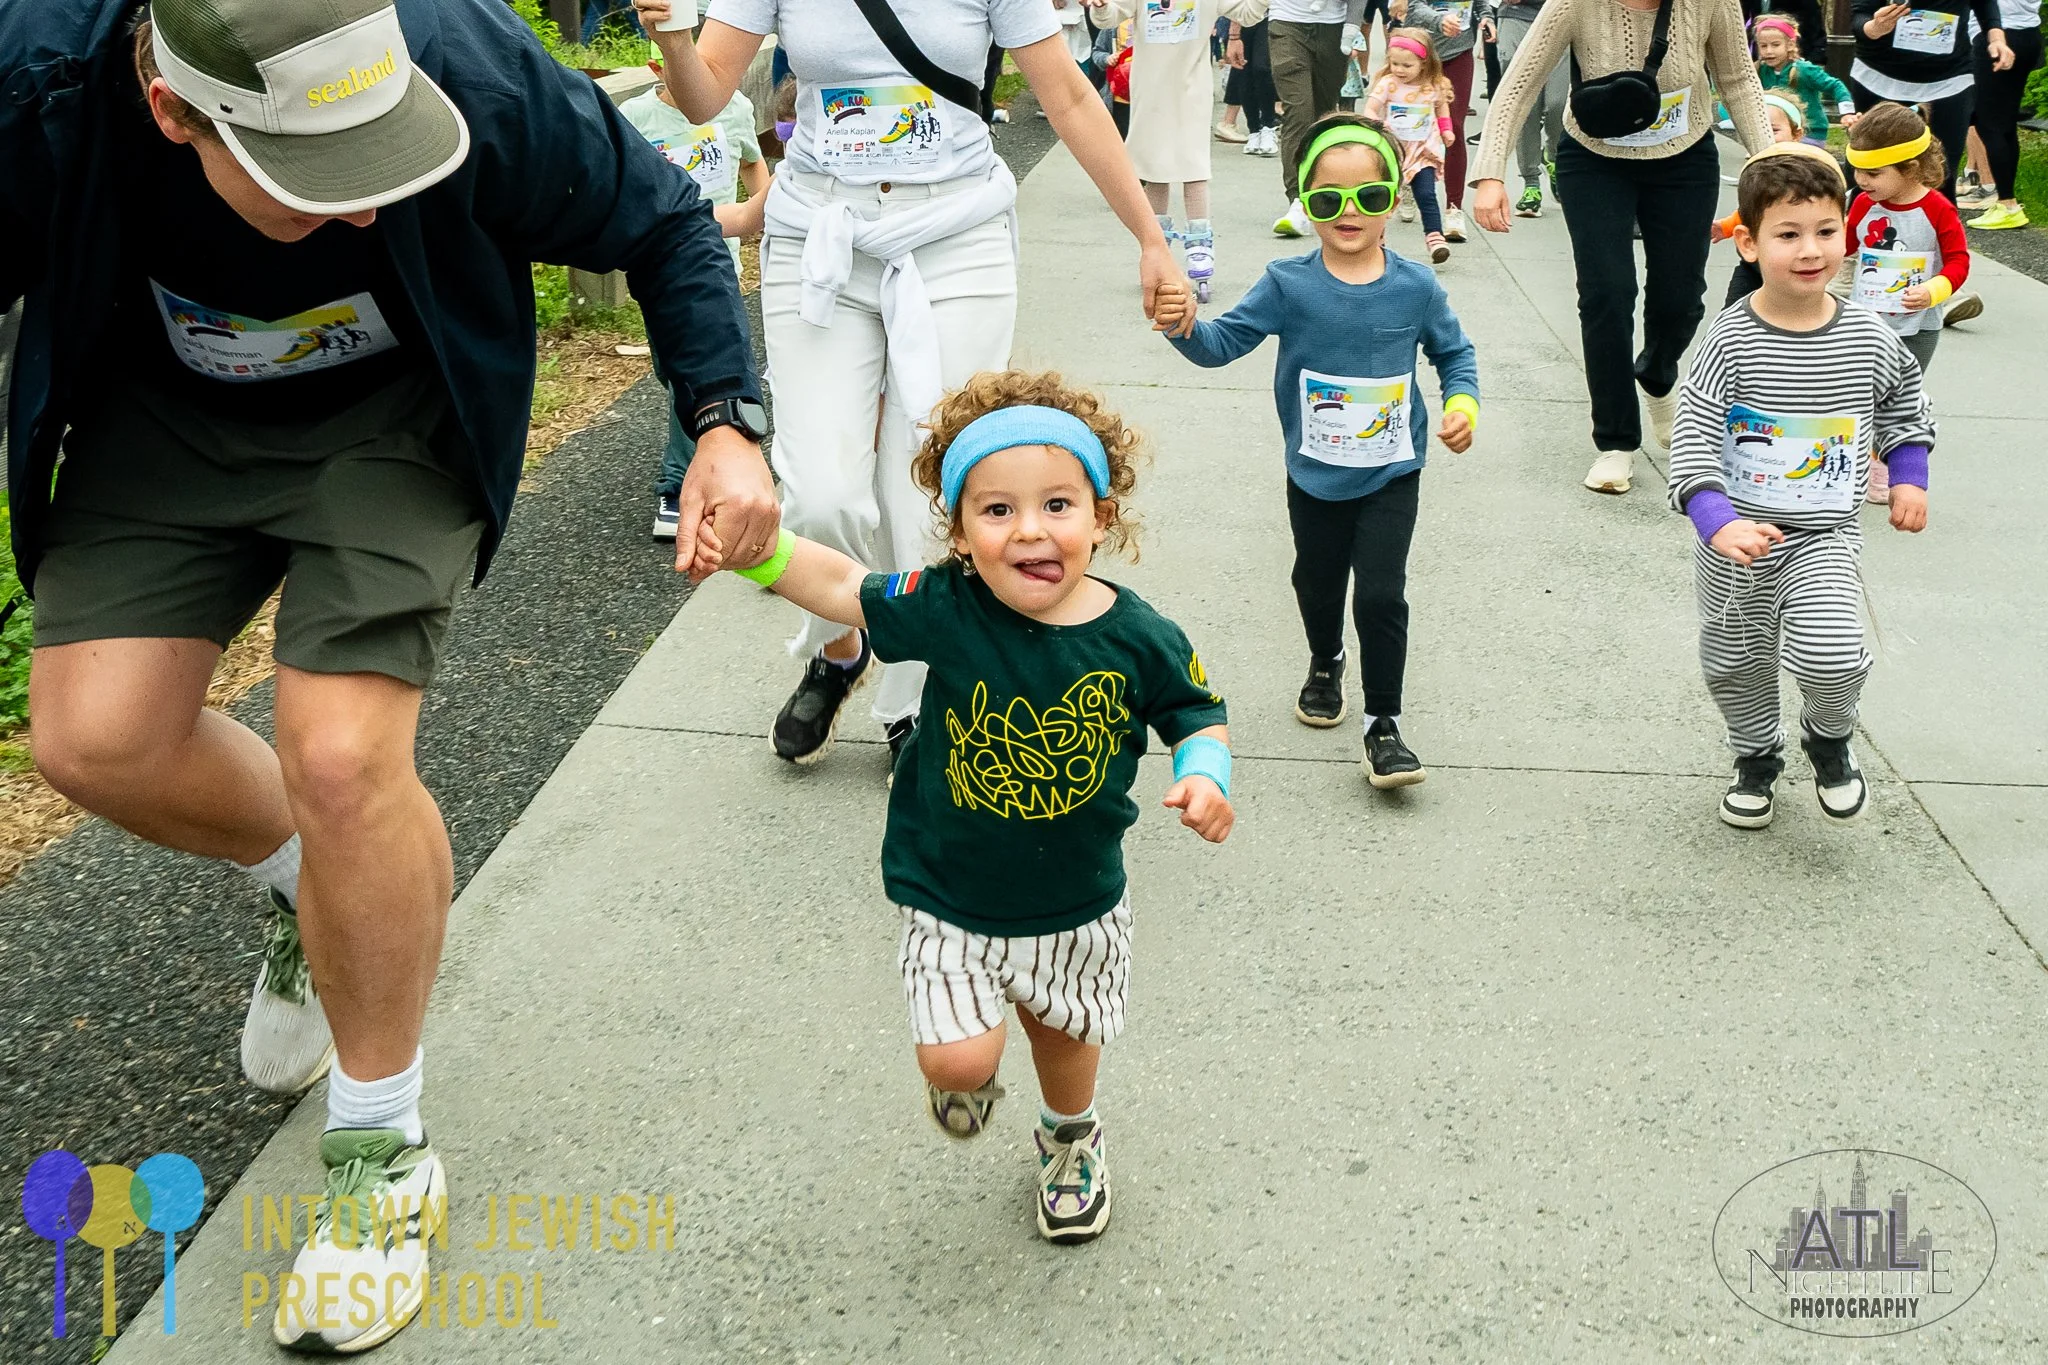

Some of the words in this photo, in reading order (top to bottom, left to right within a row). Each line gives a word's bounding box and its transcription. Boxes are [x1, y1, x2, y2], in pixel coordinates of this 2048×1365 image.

[307, 47, 397, 108] sealand
[824, 99, 844, 118] FUN
[848, 95, 872, 106] RUN
[826, 128, 849, 136] Ariella
[850, 127, 876, 137] Kaplan
[1754, 422, 1784, 438] RUN
